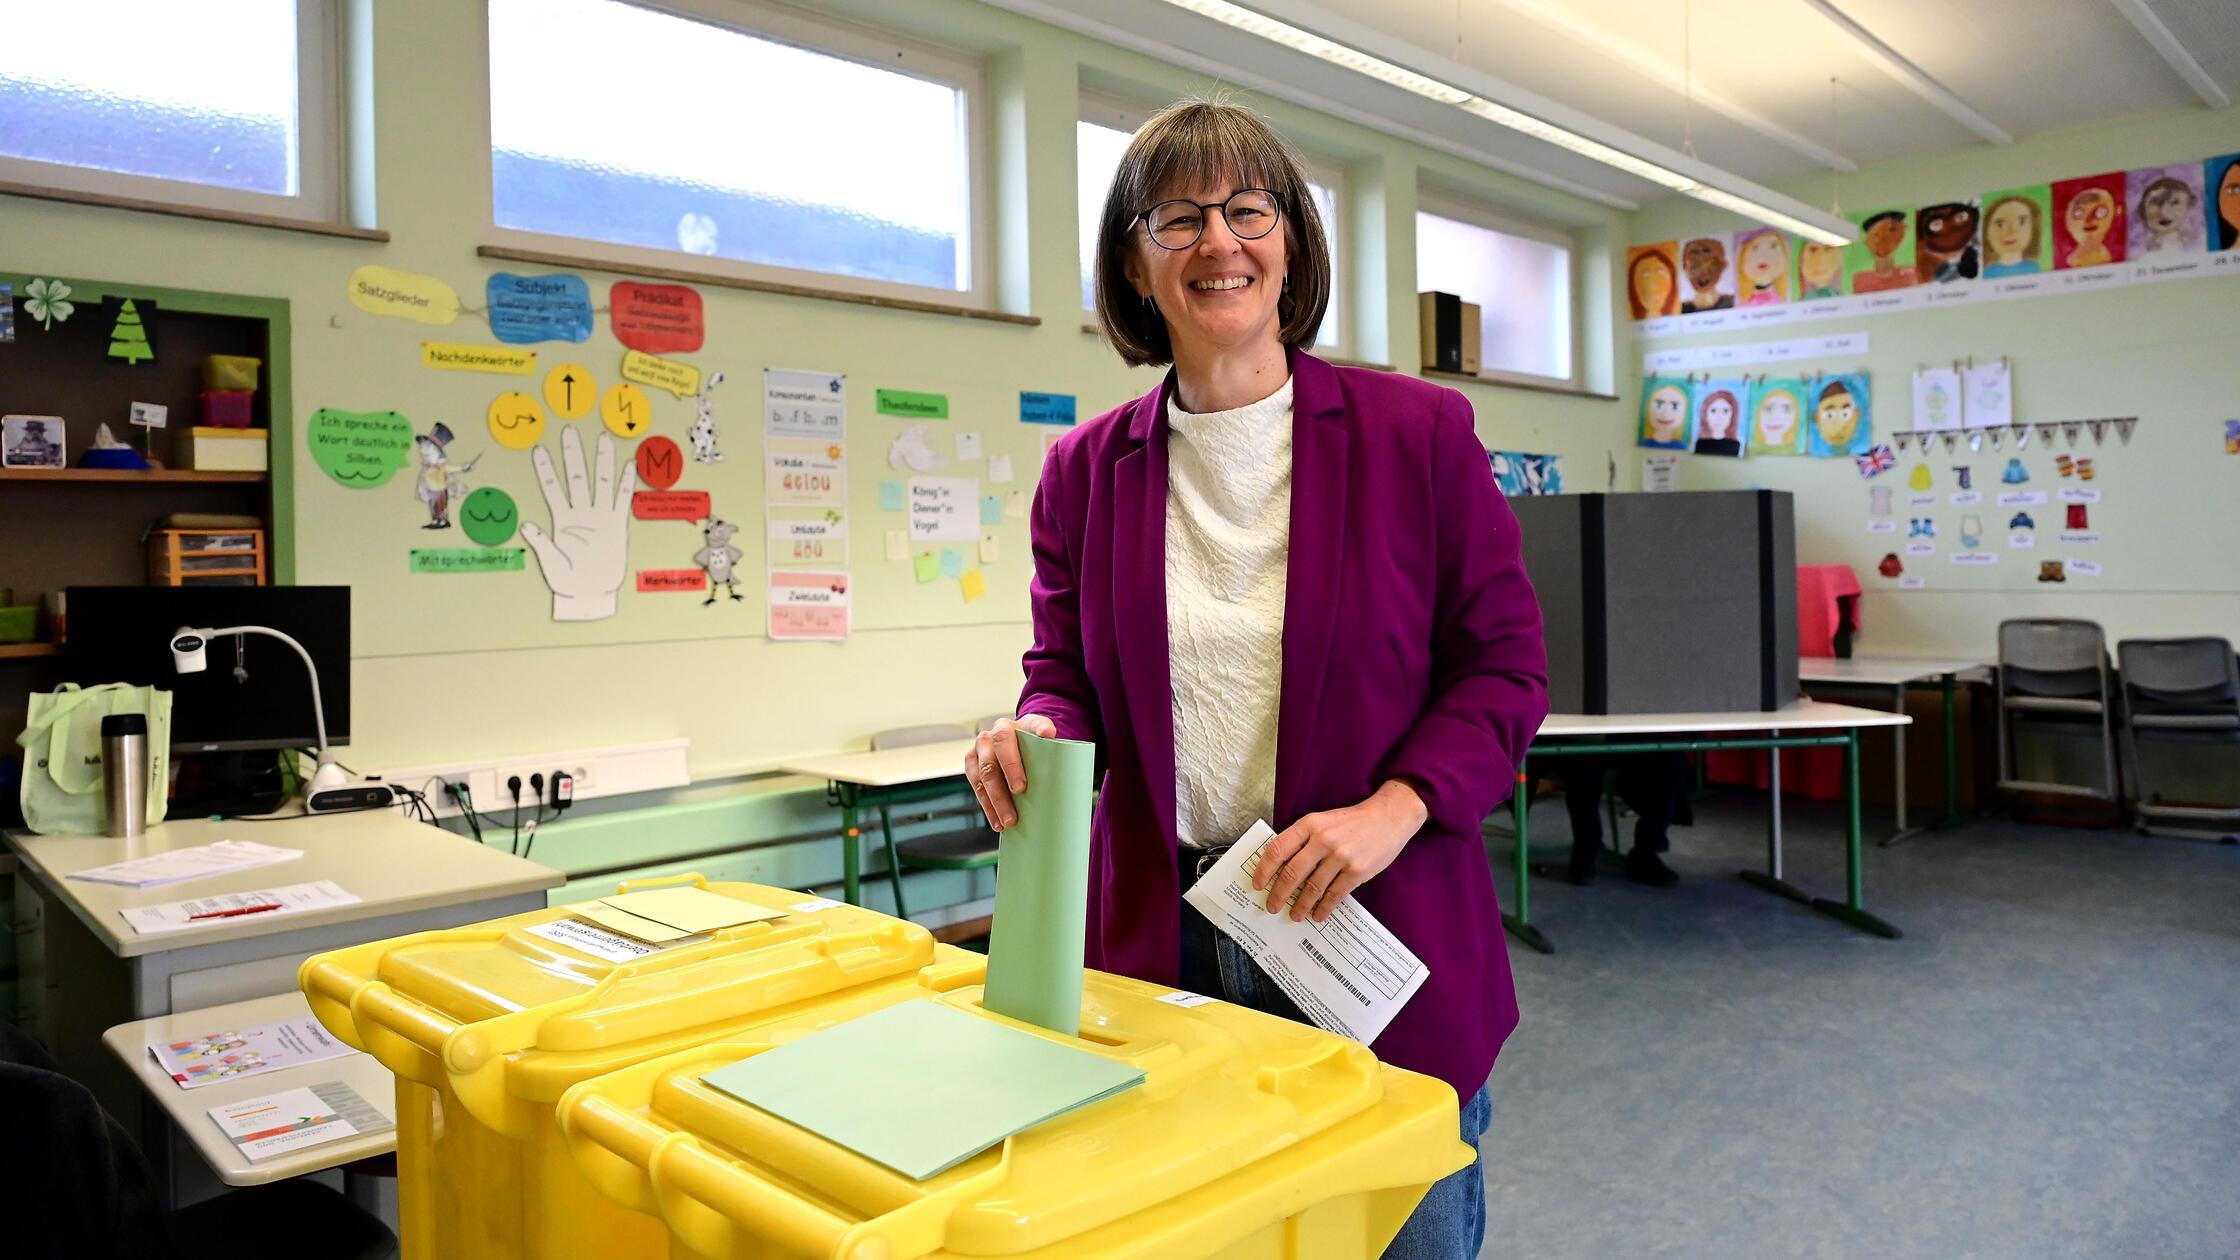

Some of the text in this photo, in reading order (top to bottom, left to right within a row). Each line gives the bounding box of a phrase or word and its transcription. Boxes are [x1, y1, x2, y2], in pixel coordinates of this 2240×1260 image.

[358, 281, 430, 308] Satzglieder
[514, 279, 566, 297] Subjekt
[633, 288, 685, 307] Prädikat
[430, 350, 526, 367] Nachdenkwörter
[320, 415, 341, 427] Ich
[345, 419, 389, 431] spreche
[318, 432, 349, 444] Wort
[352, 436, 397, 448] deutlich
[646, 447, 671, 480] M
[418, 554, 515, 568] Mitsprechwörter
[644, 574, 703, 586] Merkwörter
